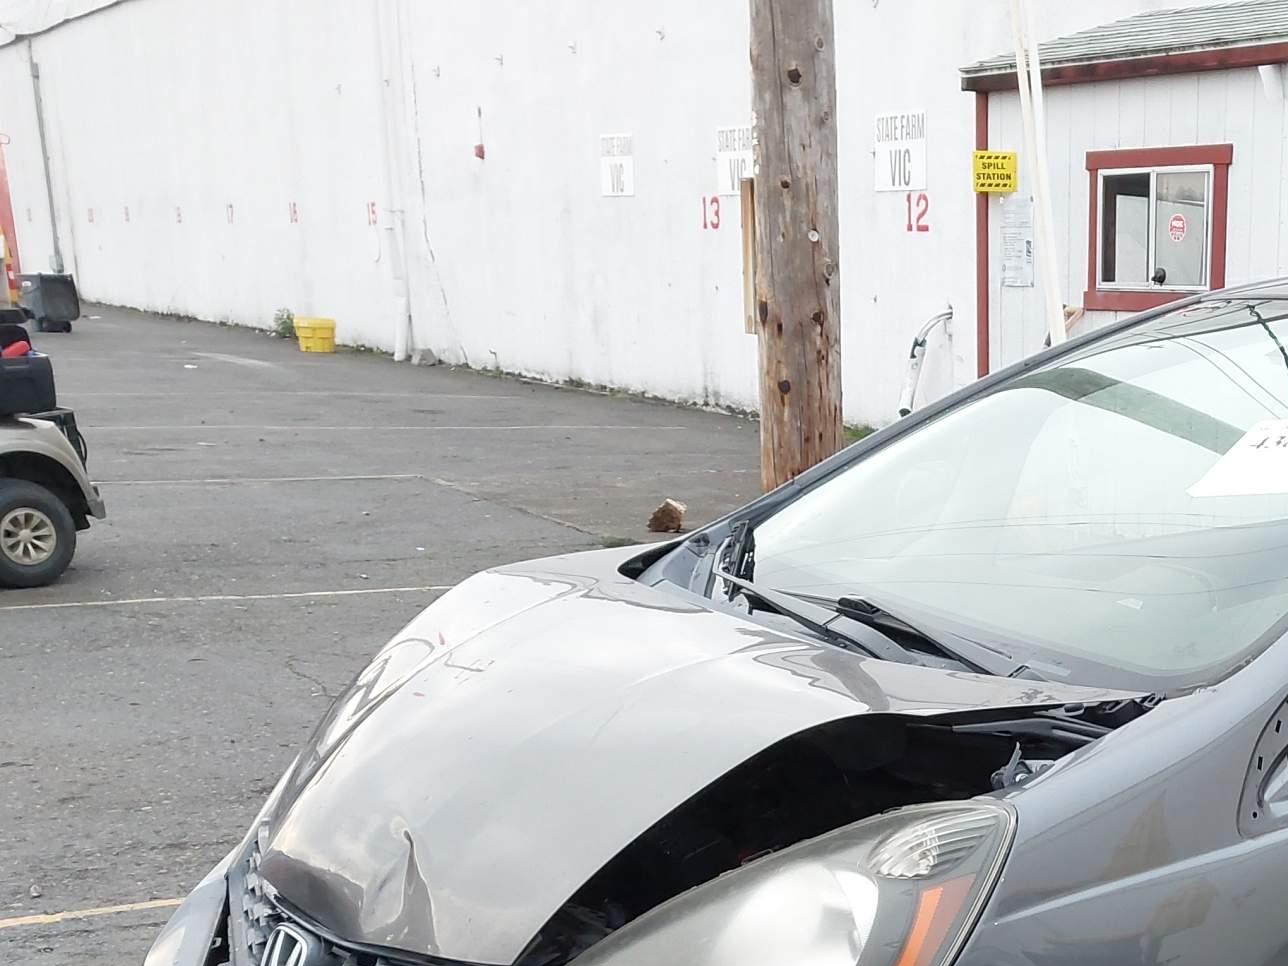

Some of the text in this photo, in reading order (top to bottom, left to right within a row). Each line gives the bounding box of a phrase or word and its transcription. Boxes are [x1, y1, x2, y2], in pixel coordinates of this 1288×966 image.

[876, 113, 925, 143] STATE FARM
[889, 148, 911, 187] VIC
[975, 172, 1012, 182] STATION
[981, 162, 1006, 170] SPILL
[702, 196, 720, 230] 13
[906, 192, 930, 232] 12
